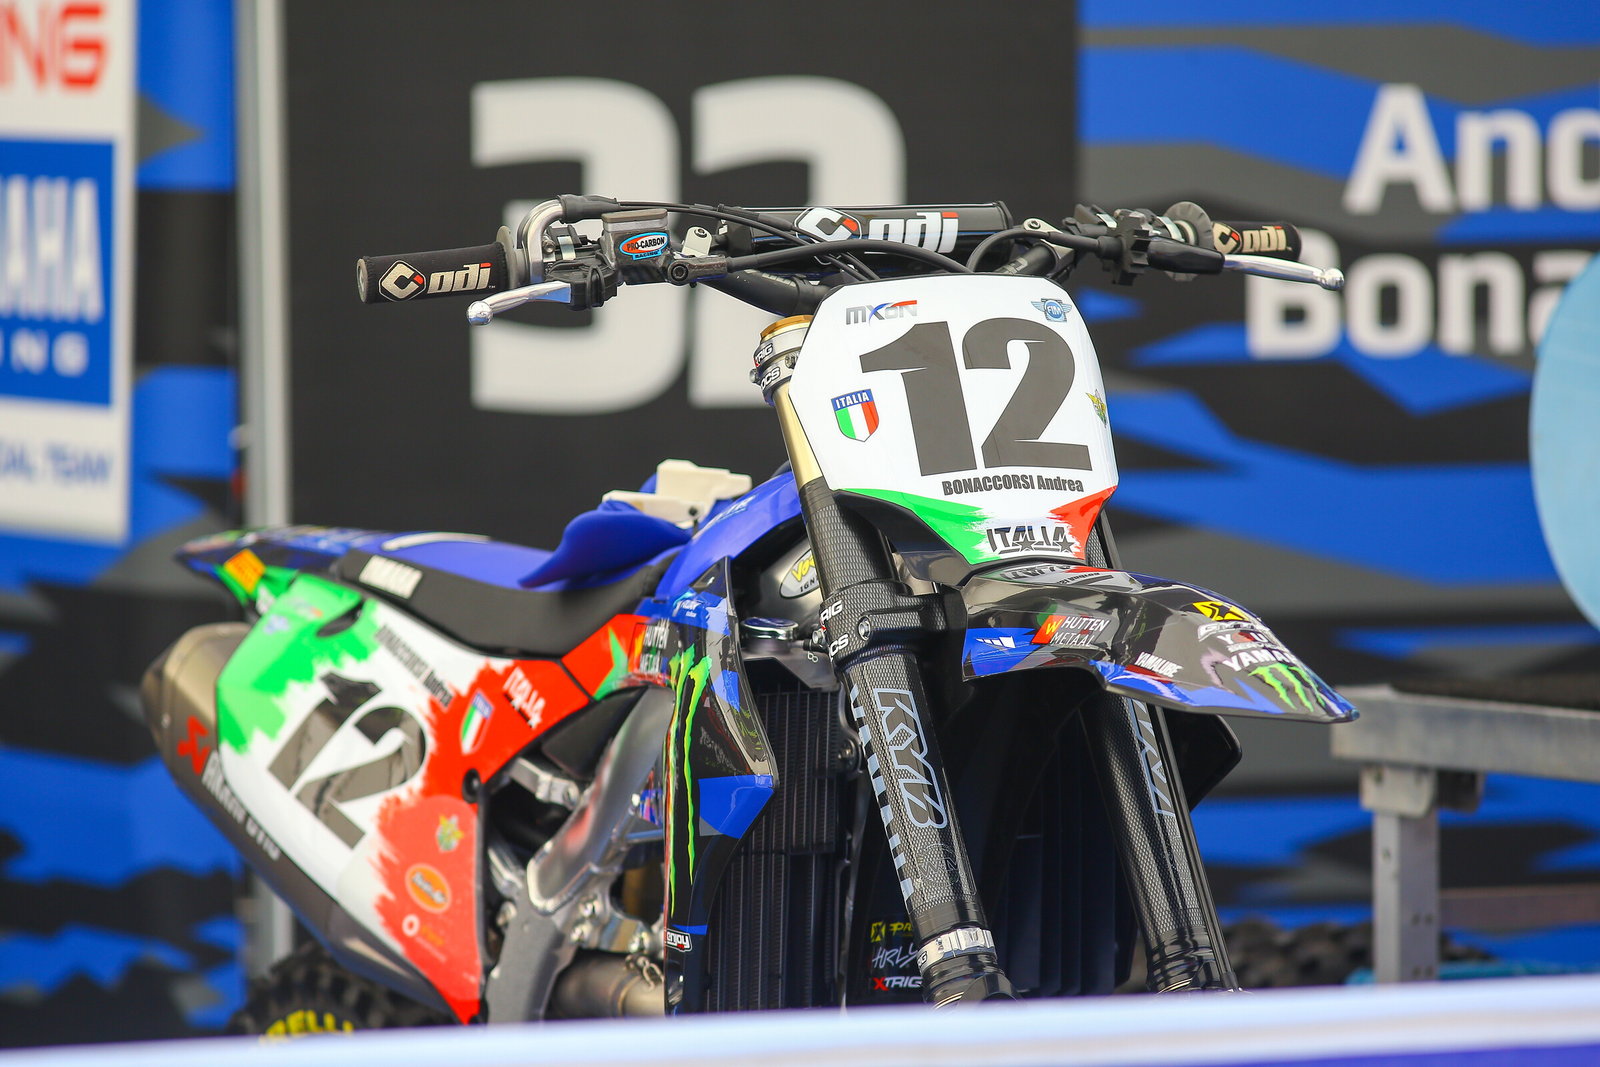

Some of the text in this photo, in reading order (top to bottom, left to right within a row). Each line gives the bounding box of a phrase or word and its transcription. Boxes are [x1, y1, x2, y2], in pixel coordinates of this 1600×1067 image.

[626, 237, 665, 251] PRO-CARBON
[868, 211, 960, 254] odi
[1242, 226, 1288, 252] odi
[427, 262, 492, 295] odi
[0, 331, 89, 377] NG
[834, 390, 871, 410] ITALIA
[858, 317, 1094, 477] 12
[941, 474, 1085, 496] BONACCORSI Andrea
[985, 525, 1078, 554] ITALIA
[1061, 616, 1110, 631] HUTTEN
[1050, 632, 1095, 647] METAAL
[1135, 651, 1183, 679] YAMALUBE
[267, 671, 426, 850] 12
[873, 688, 948, 829] KYB
[873, 976, 923, 991] XTRIG
